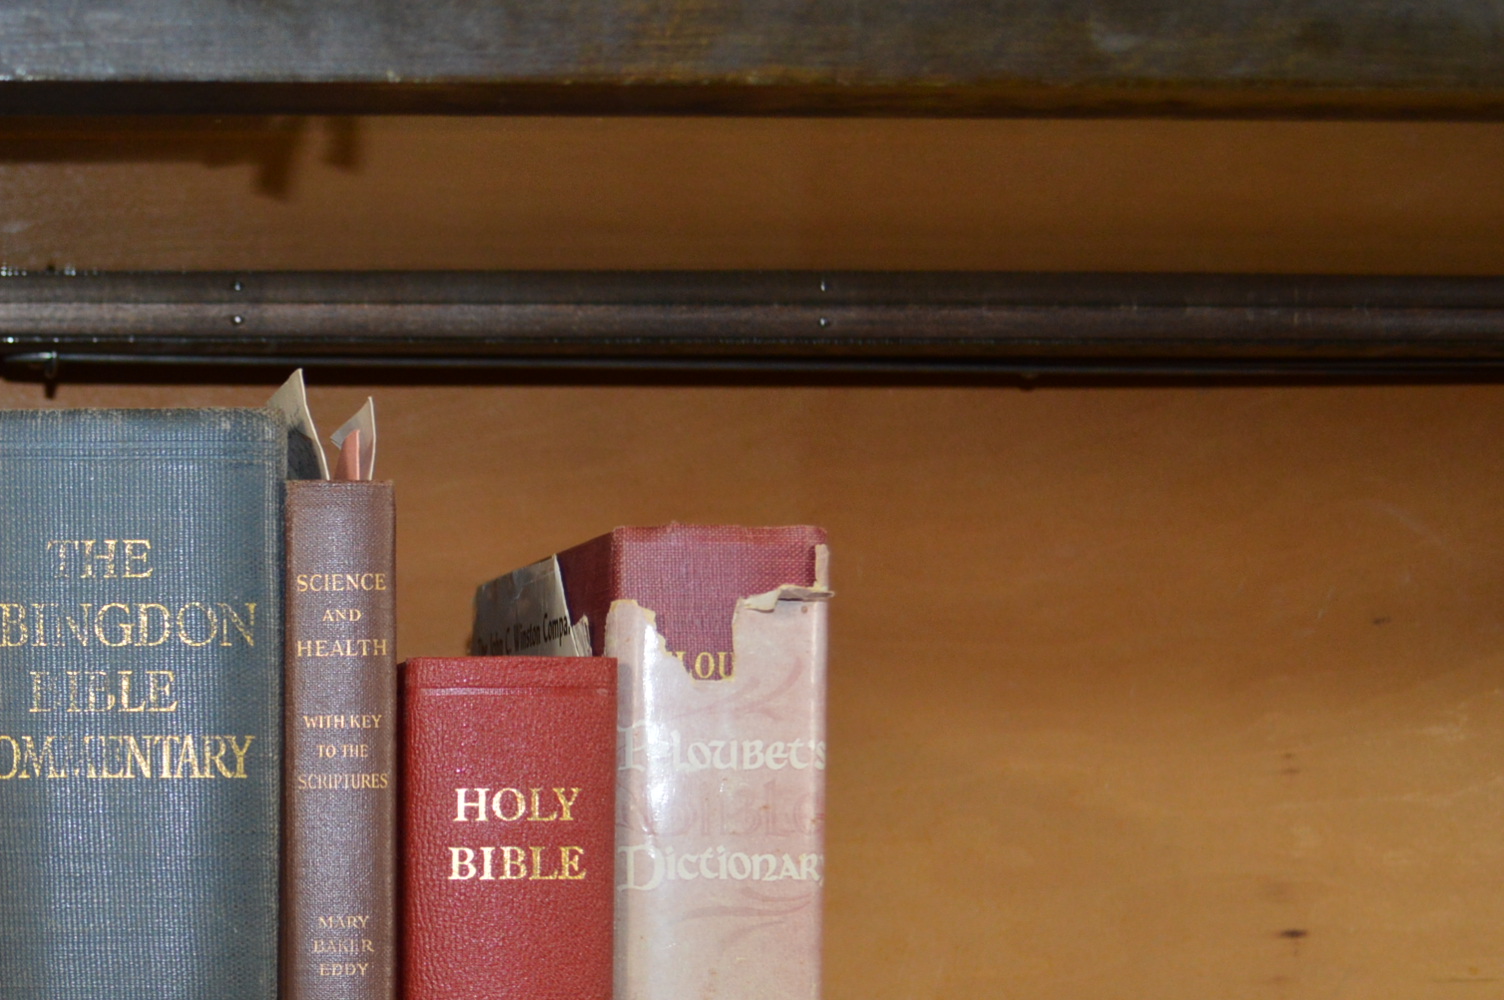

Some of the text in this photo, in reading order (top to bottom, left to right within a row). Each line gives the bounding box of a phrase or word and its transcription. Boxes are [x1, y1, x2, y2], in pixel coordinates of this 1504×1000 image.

[47, 539, 154, 579] THE
[296, 573, 387, 592] SCIENCE
[322, 609, 362, 622] AND
[296, 639, 387, 657] HEALTH
[303, 714, 383, 729] WITH KEY
[317, 744, 369, 758] TO THE
[297, 773, 389, 790] SCRIPTURES
[453, 787, 582, 822] HOLY
[447, 845, 587, 881] BIBLE
[318, 914, 370, 929] MARY
[319, 962, 369, 977] EDDY
